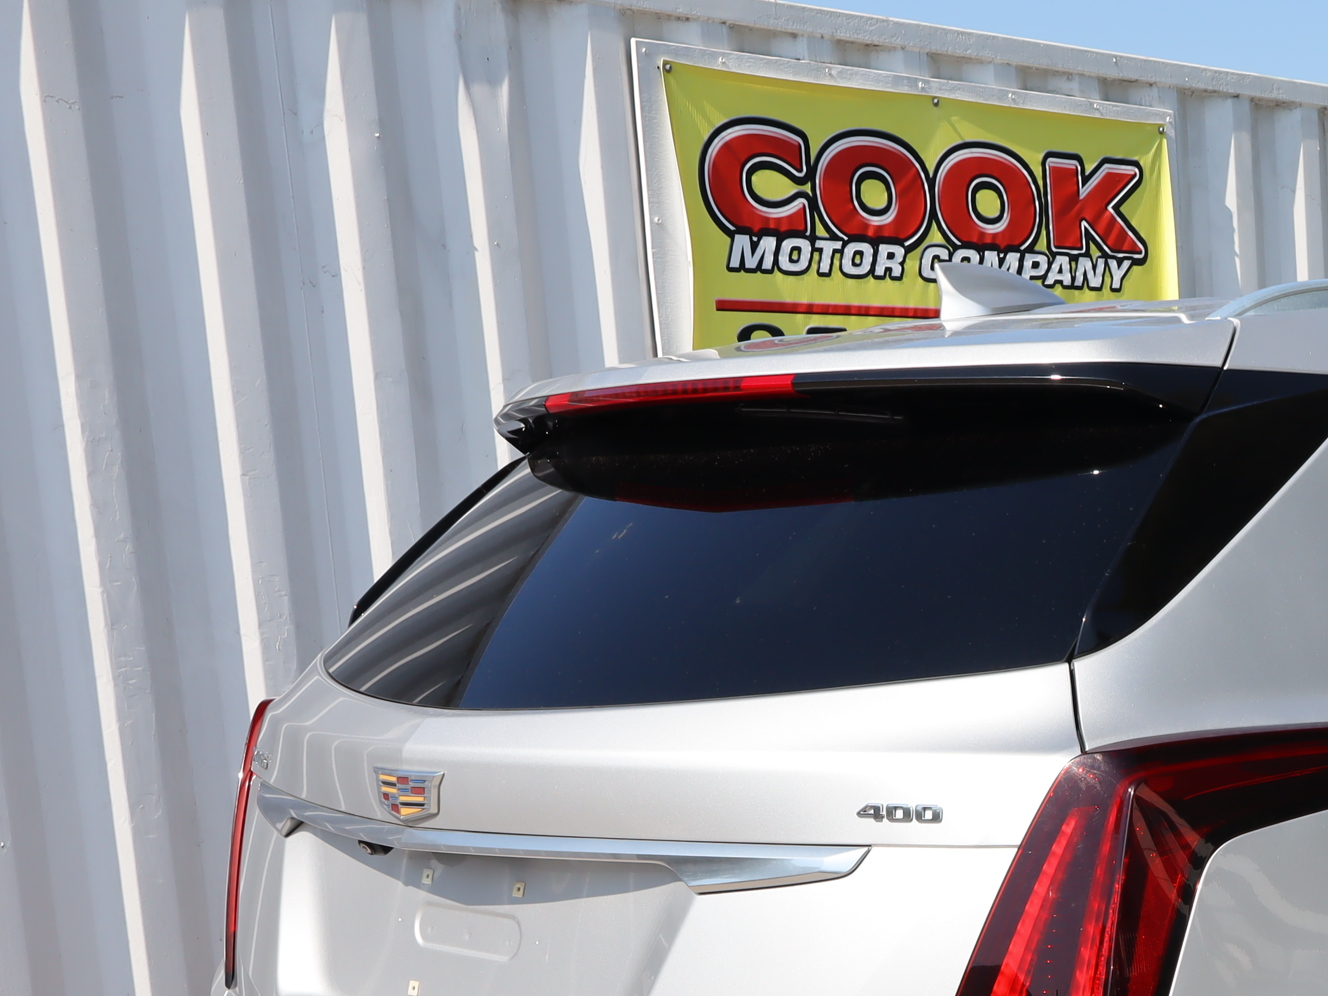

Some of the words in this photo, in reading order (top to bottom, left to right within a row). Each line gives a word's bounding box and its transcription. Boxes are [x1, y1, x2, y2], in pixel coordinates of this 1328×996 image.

[700, 117, 1147, 261] COOK
[727, 233, 905, 279] MOTOR
[856, 803, 944, 823] 400
